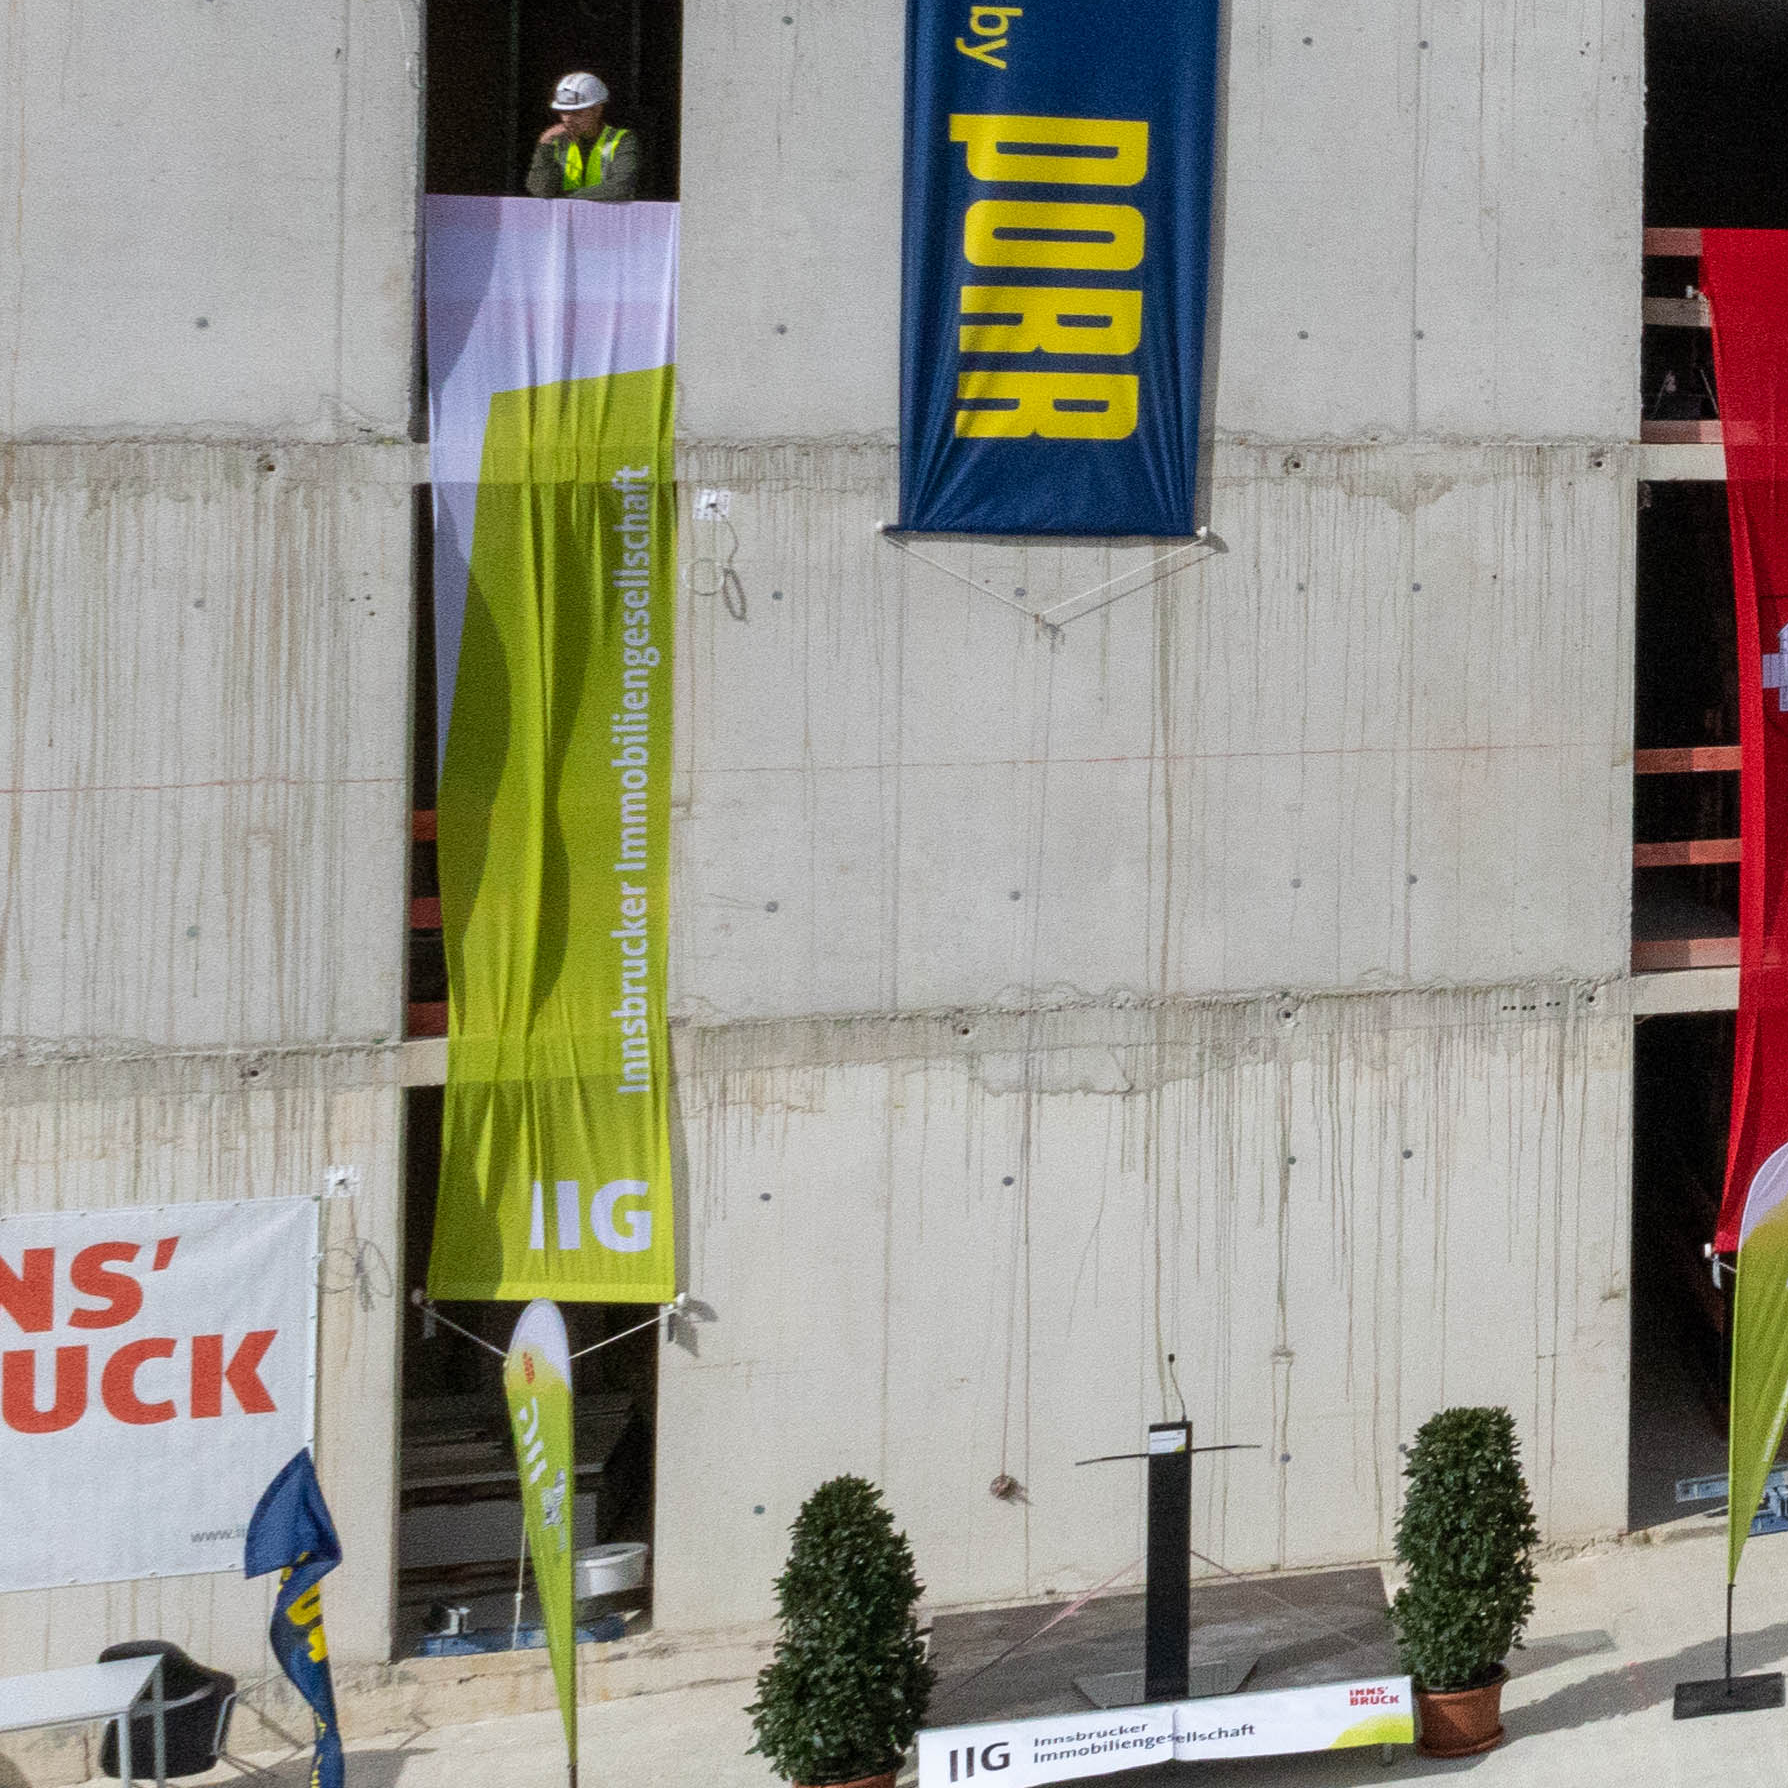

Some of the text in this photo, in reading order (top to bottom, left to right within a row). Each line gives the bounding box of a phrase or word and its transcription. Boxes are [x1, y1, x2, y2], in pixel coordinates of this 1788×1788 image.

[955, 6, 1024, 69] by
[948, 113, 1150, 441] PORR
[611, 465, 660, 1094] Innsbrucker Immobiliengesellschaft
[528, 1179, 653, 1253] IIG
[2, 1328, 279, 1434] UCK
[1350, 1694, 1400, 1706] BRUCK
[949, 1742, 1011, 1783] IIG
[1033, 1722, 1149, 1747] Innsbrucker
[1033, 1723, 1256, 1764] Immobiliengesellschaft
